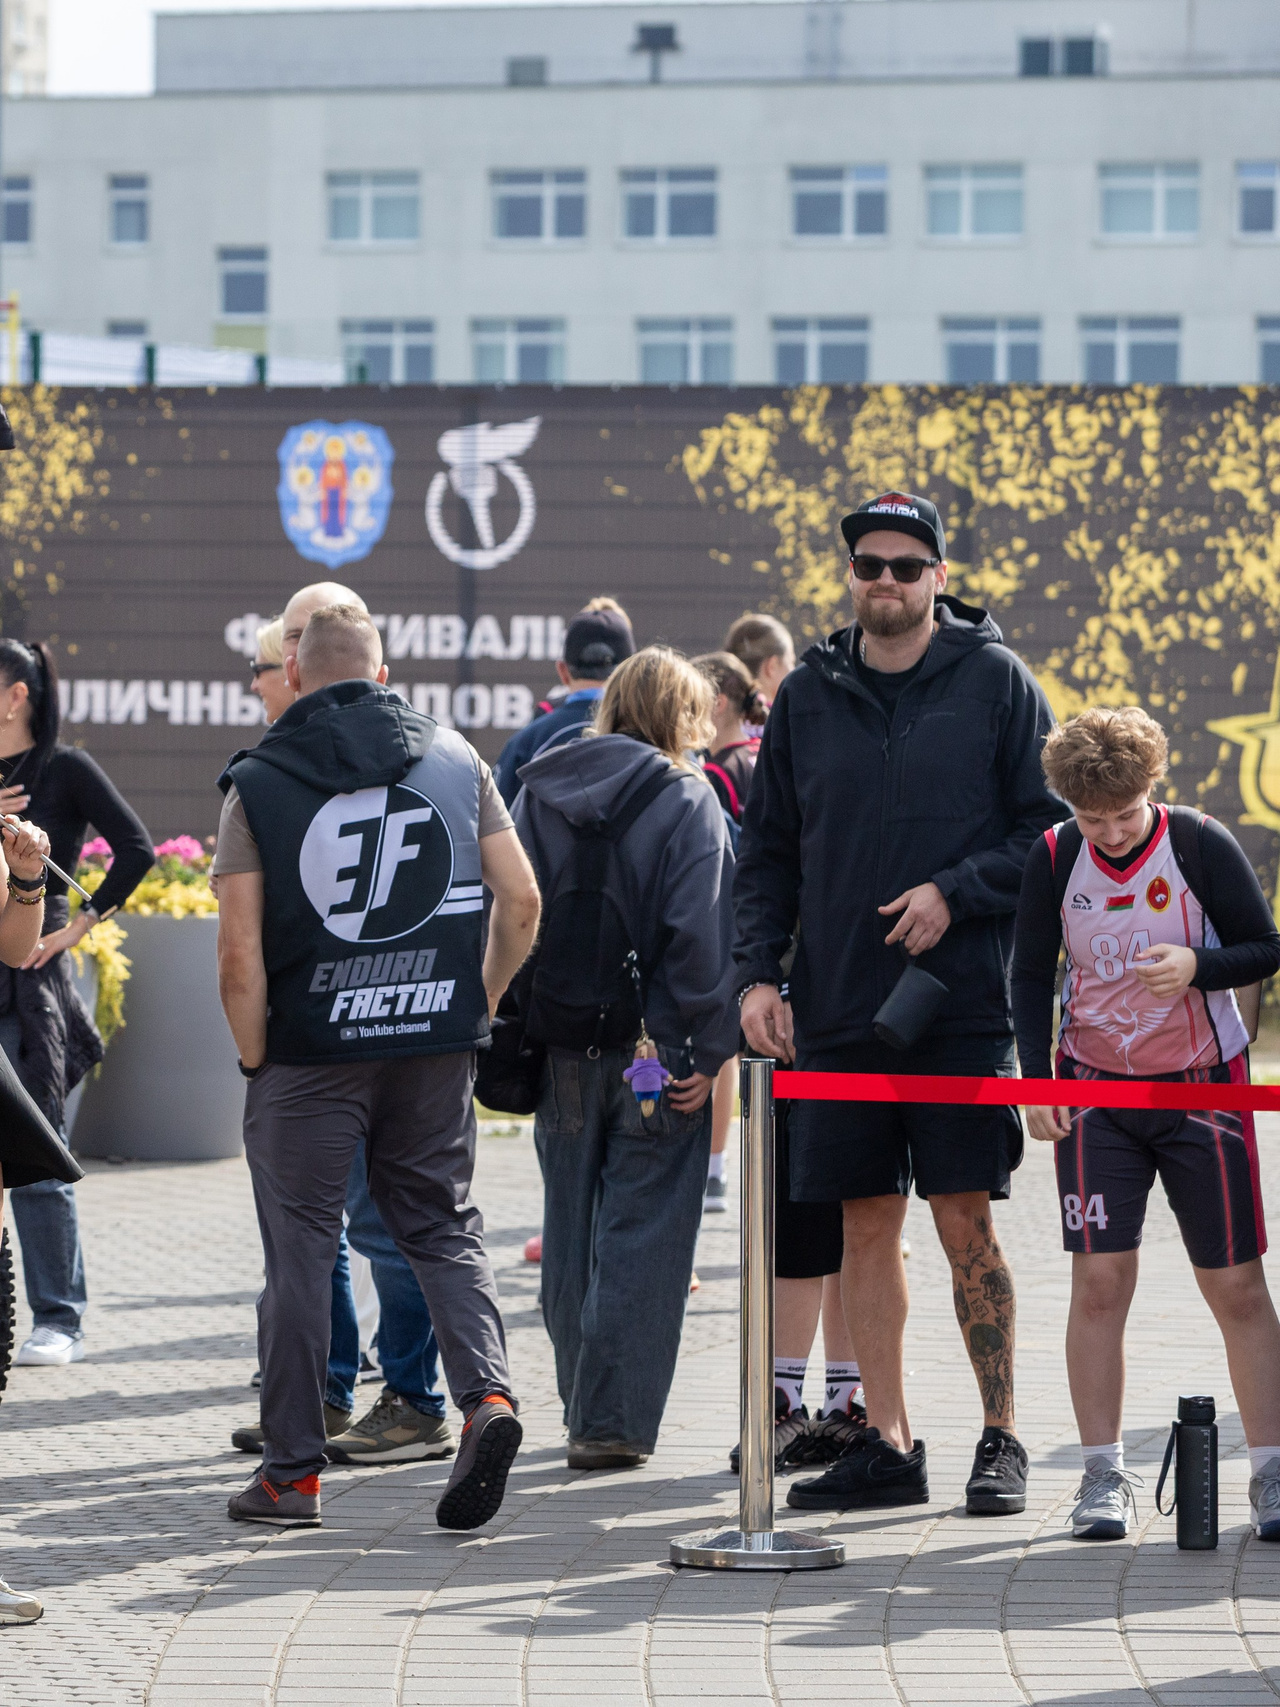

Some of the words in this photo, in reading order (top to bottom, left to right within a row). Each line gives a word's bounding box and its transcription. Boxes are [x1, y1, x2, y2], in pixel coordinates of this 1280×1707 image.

[308, 948, 437, 993] ENDURO
[1090, 929, 1160, 983] 84
[329, 979, 456, 1023] FACTOR
[358, 1024, 394, 1038] YouTube
[396, 1020, 431, 1035] channel
[1064, 1193, 1108, 1232] 84
